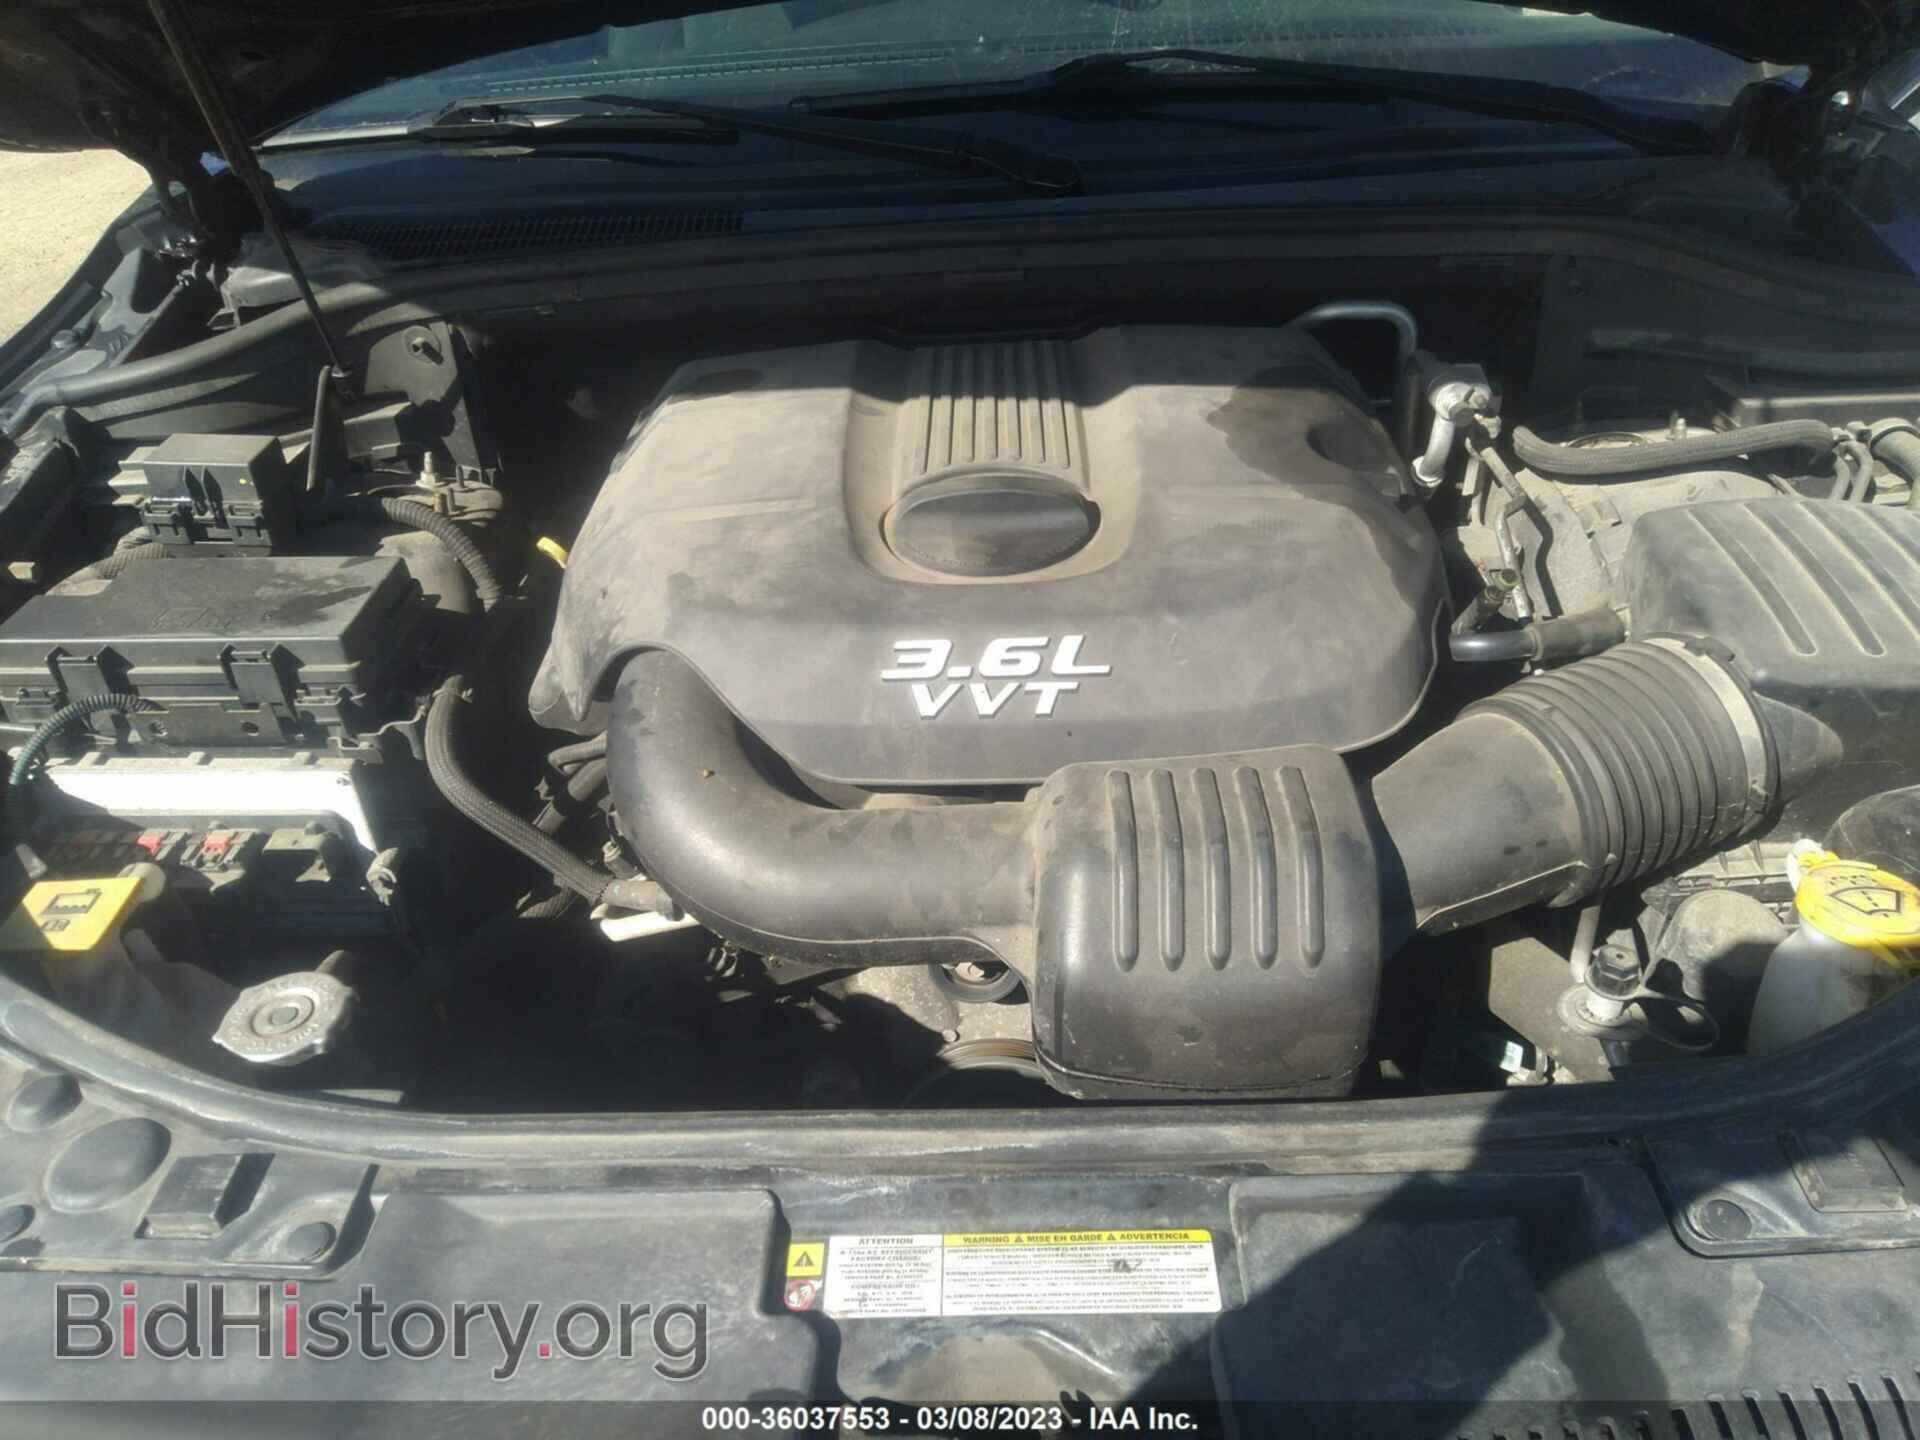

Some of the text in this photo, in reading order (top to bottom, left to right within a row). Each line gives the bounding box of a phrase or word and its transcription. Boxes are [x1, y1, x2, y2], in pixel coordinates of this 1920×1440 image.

[881, 634, 1111, 681] 3.6L
[911, 681, 1079, 719] VVT
[858, 1237, 914, 1246] ATTENTION
[962, 1232, 1190, 1244] WARNING MISE EN GARDE ADVERTENCIA
